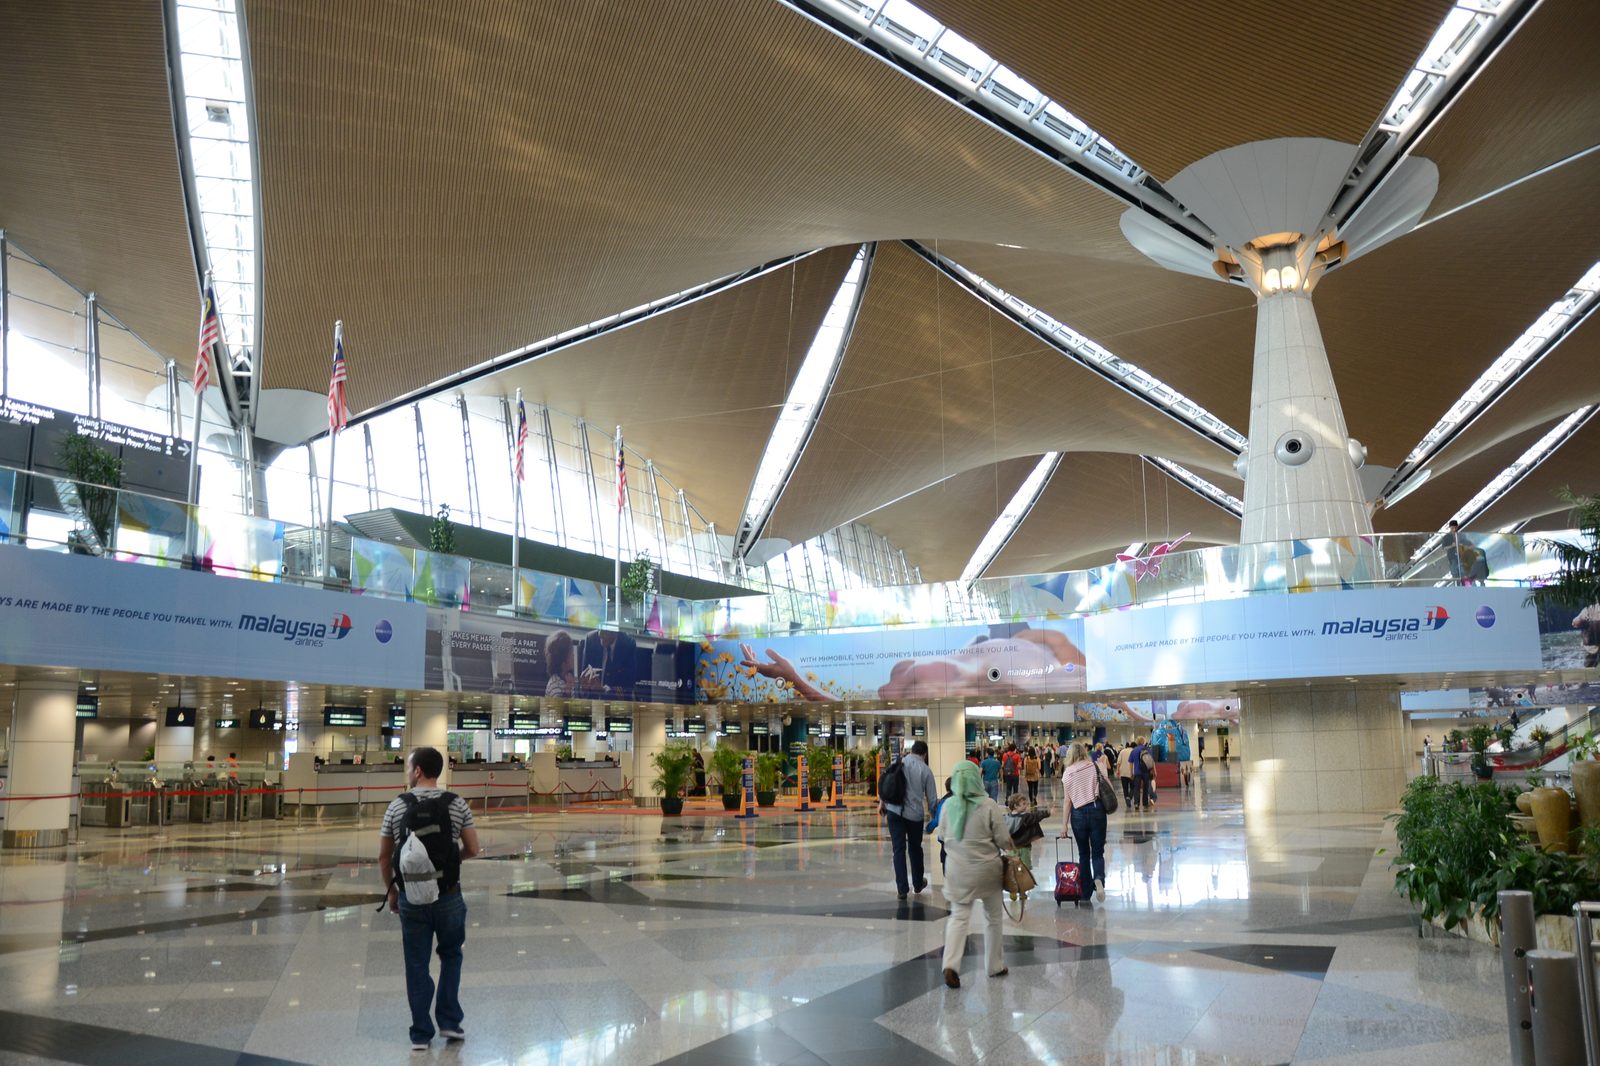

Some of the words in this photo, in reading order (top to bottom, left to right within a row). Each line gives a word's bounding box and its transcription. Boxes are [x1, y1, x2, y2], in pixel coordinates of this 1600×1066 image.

[4, 398, 55, 420] Kanak-kanak
[10, 411, 24, 422] Play
[23, 413, 40, 424] Area
[73, 415, 99, 430] Anjung
[100, 421, 122, 434] Tinjau
[126, 438, 144, 449] Prayer
[145, 442, 162, 452] Room
[15, 599, 38, 608] ARE
[41, 602, 73, 612] MADE
[75, 604, 90, 614] BY
[91, 606, 110, 616] THE
[112, 608, 150, 620] PEOPLE
[152, 613, 172, 622] YOU
[174, 615, 206, 626] TRAVEL
[209, 619, 234, 629] WITH.
[238, 614, 326, 641] malaysia
[1322, 617, 1420, 638] malaysia
[294, 638, 324, 648] airlines
[450, 632, 470, 641] MAKES
[471, 634, 480, 642] ME
[1114, 642, 1143, 652] JOURNEYS
[1159, 639, 1178, 647] MADE
[1206, 634, 1236, 642] PEOPLE
[1238, 632, 1256, 640] YOU
[1258, 630, 1288, 639] TRAVEL
[1292, 629, 1316, 637] WITH.
[1385, 632, 1418, 641] airlines
[452, 641, 471, 649] EVERY
[876, 650, 911, 659] JOURNEYS
[958, 647, 984, 655] WHERE
[1007, 668, 1044, 678] malaysia
